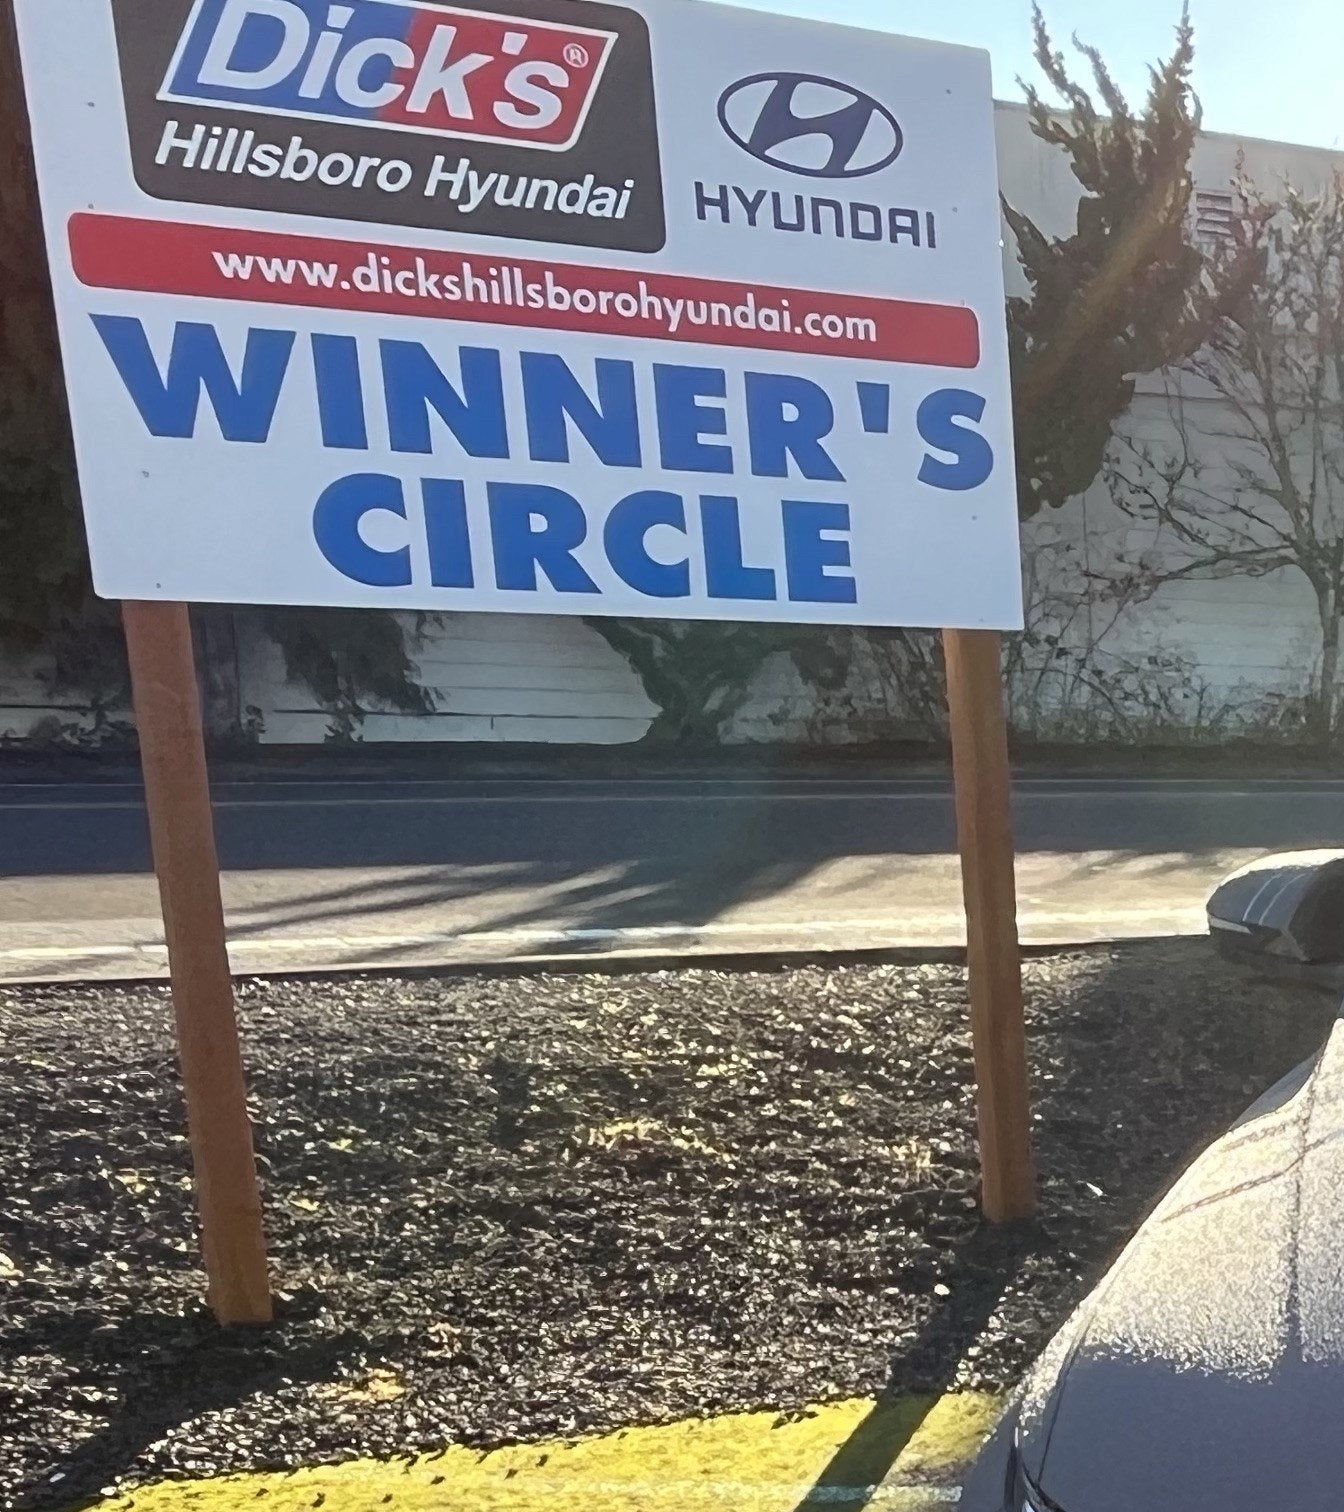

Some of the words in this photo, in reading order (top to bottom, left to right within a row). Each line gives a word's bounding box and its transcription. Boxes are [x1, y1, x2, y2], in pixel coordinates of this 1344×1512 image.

[154, 119, 412, 193] Hillsboro
[423, 154, 635, 220] Hyundai
[694, 181, 937, 250] HYUNDAI
[212, 247, 879, 344] www.dickshillsborohyundai.com
[87, 312, 994, 492] WINNER'S
[311, 471, 859, 605] CIRCLE
